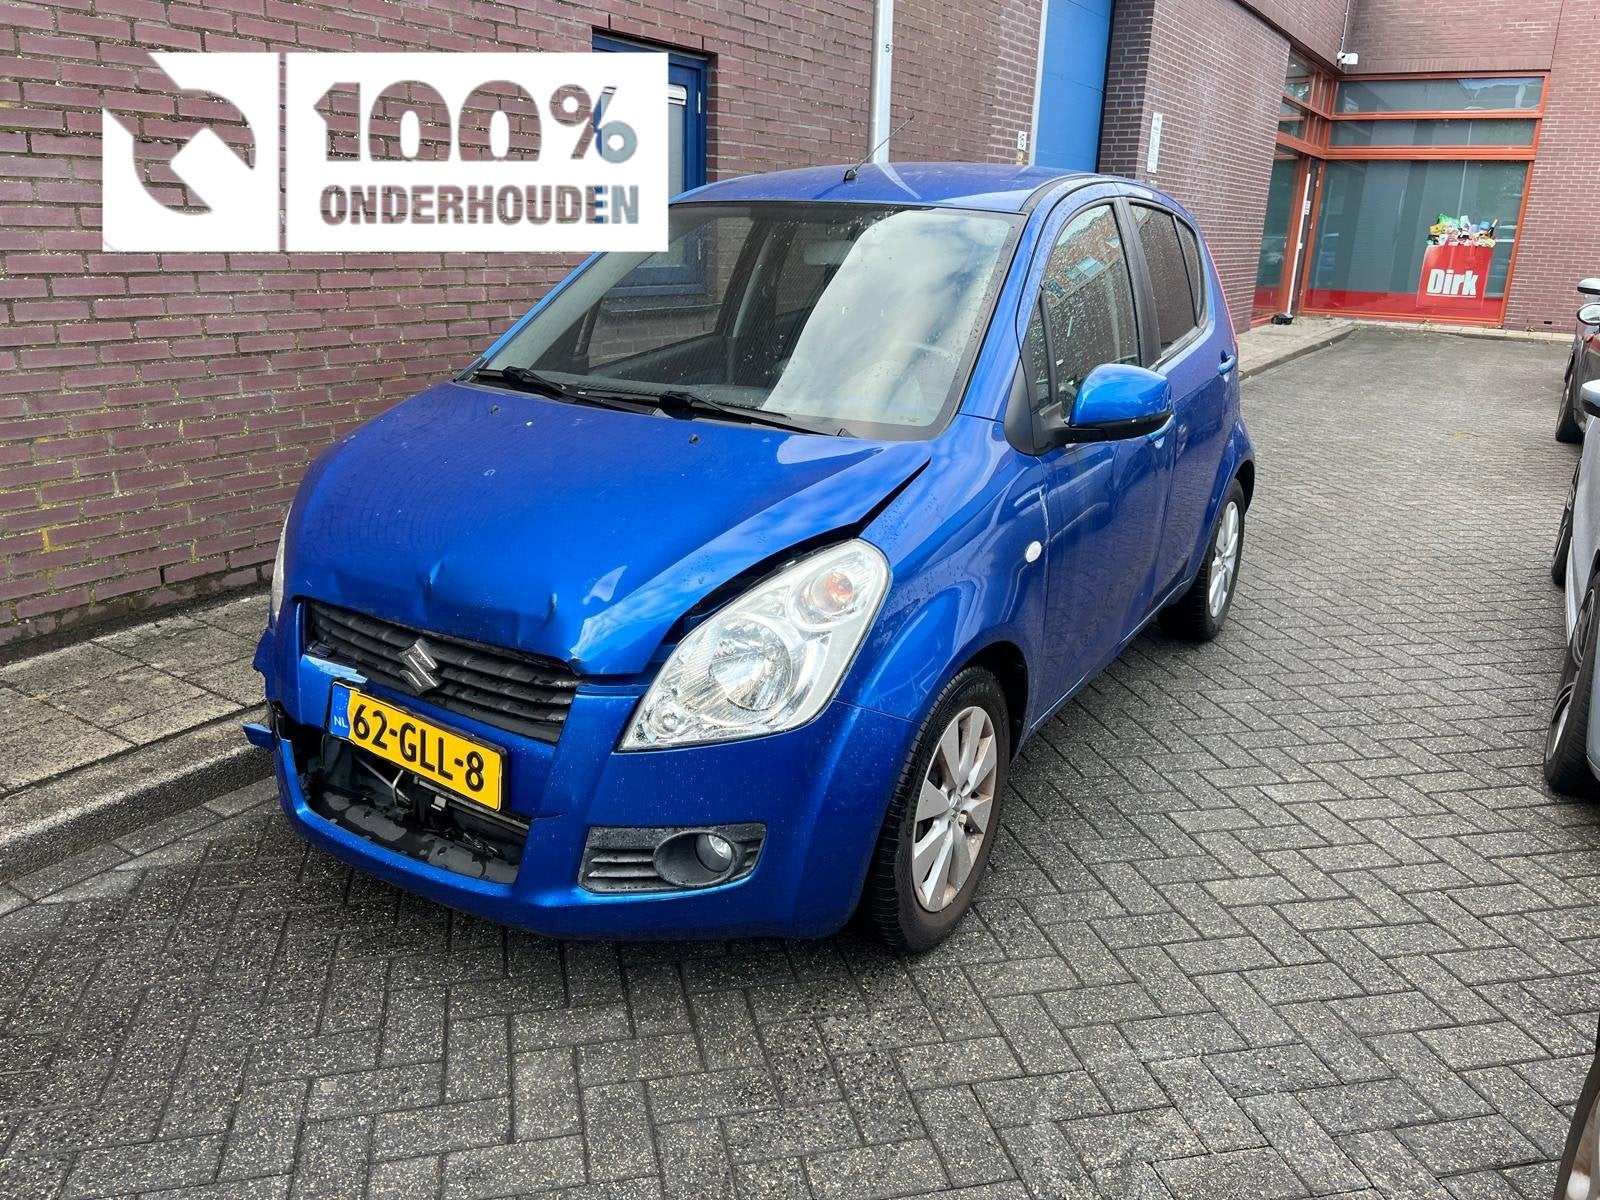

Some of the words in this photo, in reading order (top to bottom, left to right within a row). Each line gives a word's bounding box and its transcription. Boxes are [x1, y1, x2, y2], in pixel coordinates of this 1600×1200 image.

[1427, 269, 1479, 296] Dirk
[333, 715, 350, 730] NL
[353, 704, 485, 793] 62-GLL-8
